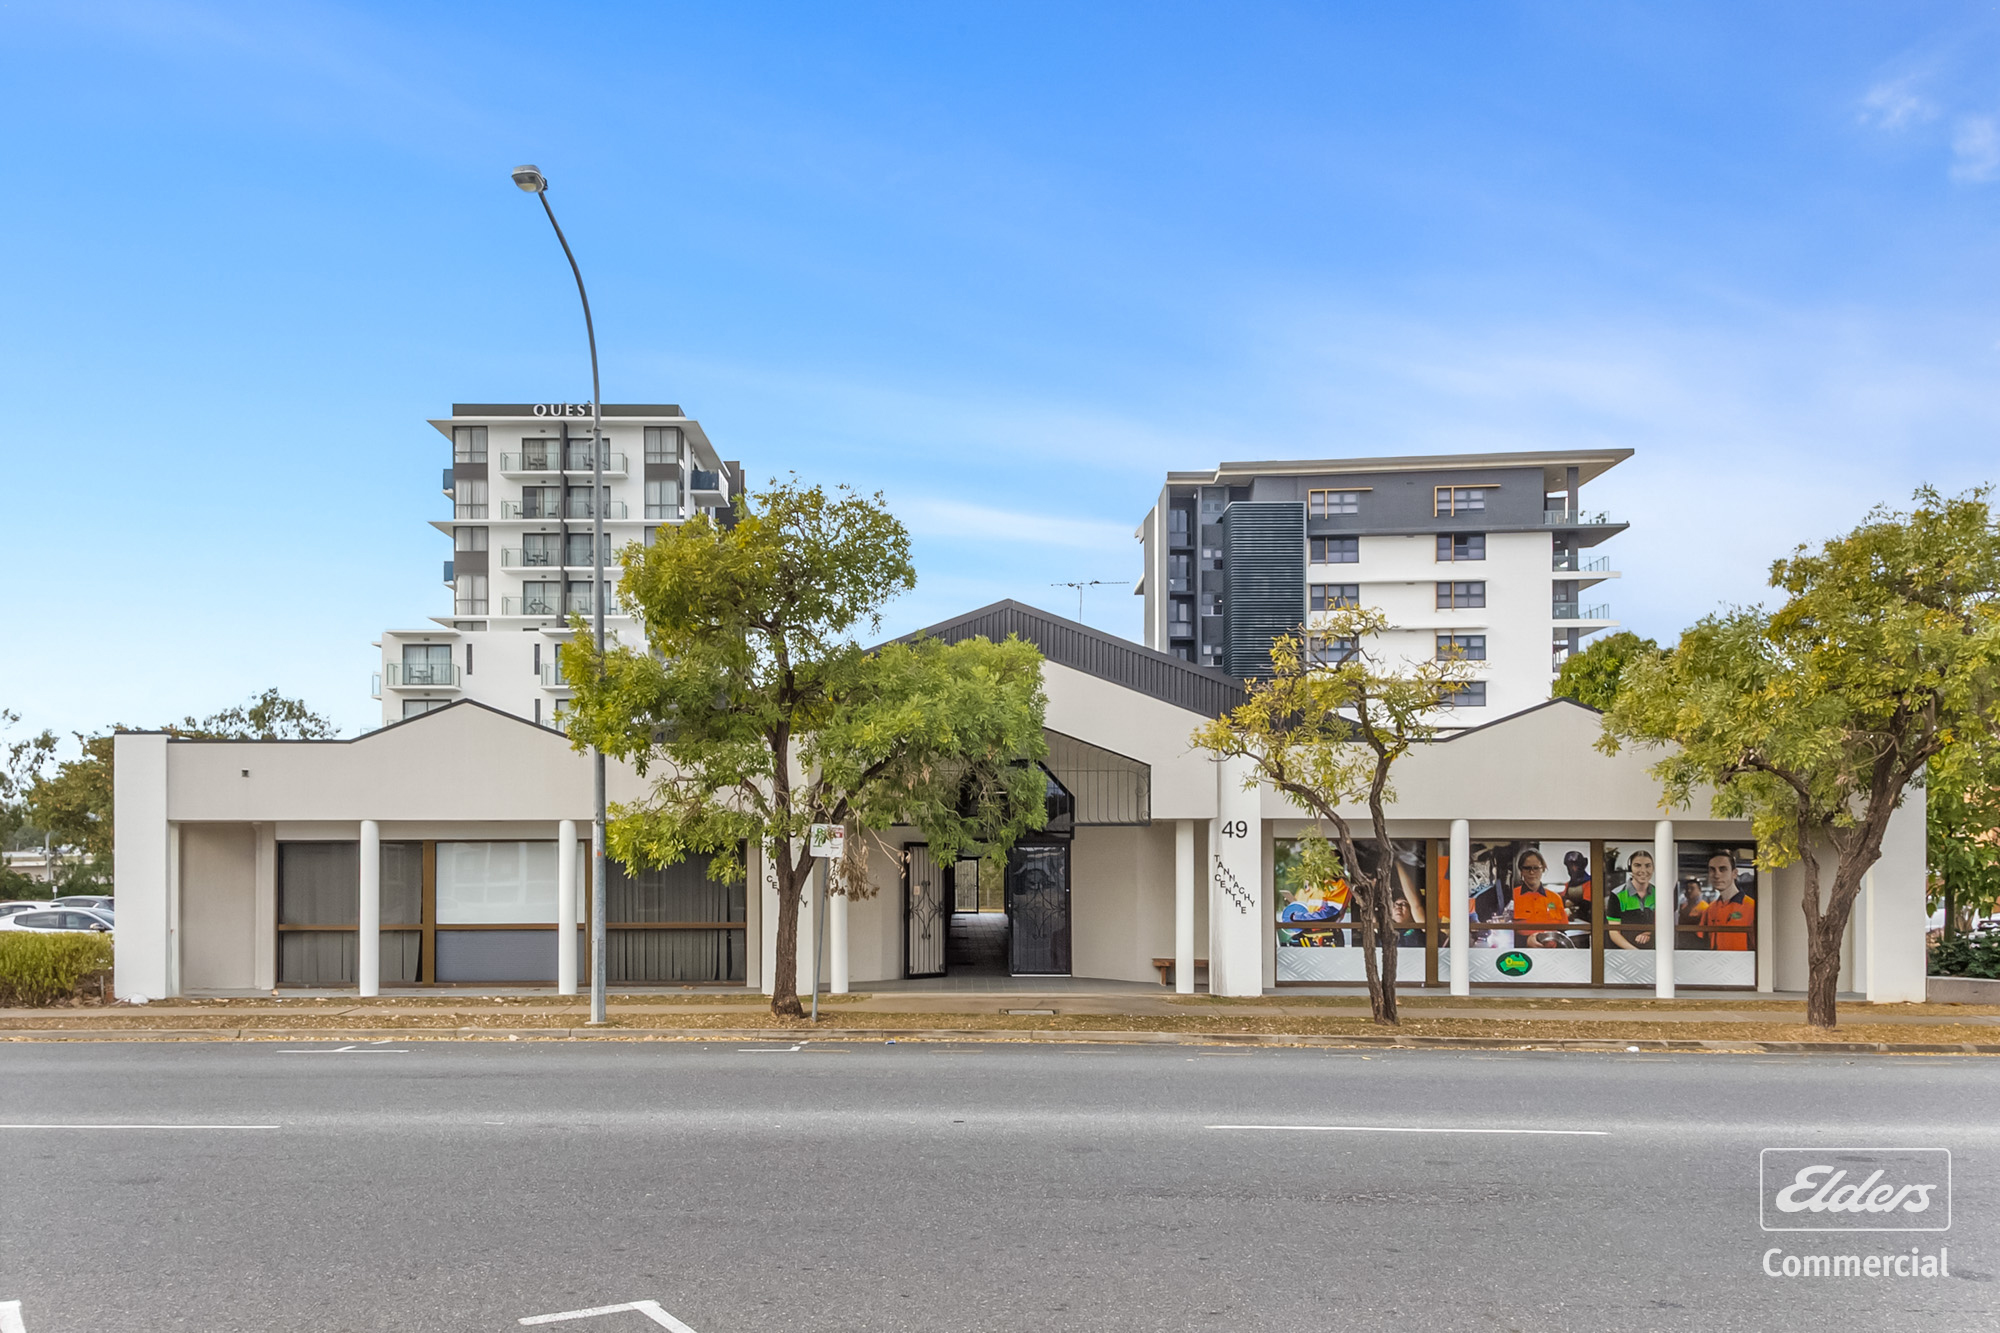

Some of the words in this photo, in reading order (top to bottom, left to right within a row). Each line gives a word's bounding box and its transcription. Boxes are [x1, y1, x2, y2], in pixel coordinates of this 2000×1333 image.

[1221, 820, 1248, 839] 49
[1214, 854, 1256, 907] TANNACHY
[1214, 873, 1247, 915] CENTRE
